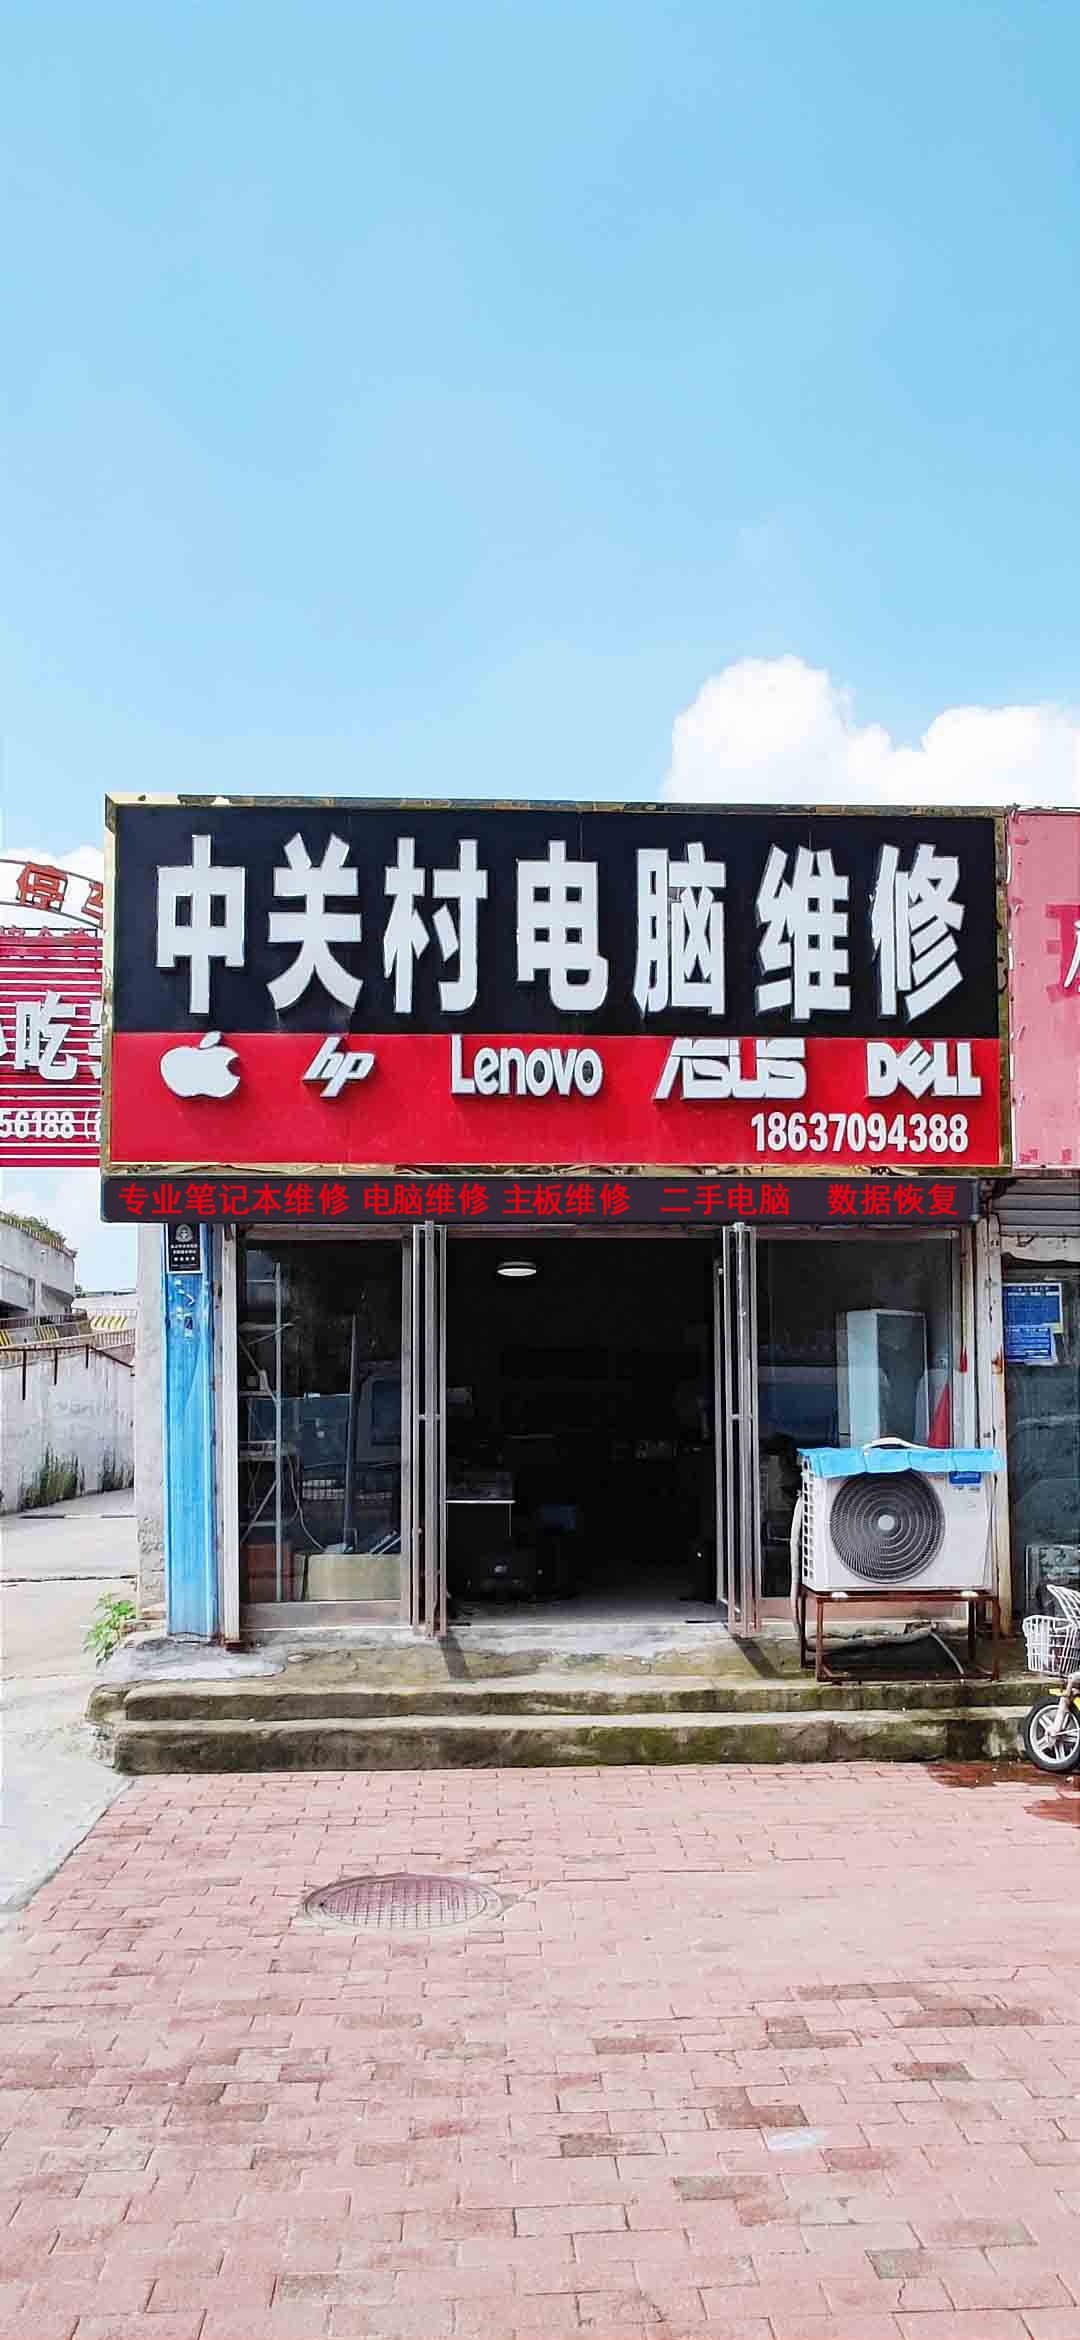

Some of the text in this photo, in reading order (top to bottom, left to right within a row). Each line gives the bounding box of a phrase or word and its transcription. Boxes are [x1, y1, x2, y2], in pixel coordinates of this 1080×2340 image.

[156, 833, 965, 1021] 中关村电脑维修
[303, 1035, 982, 1099] hp Lenovo ASUS DELL
[751, 1111, 969, 1153] 18637094388
[119, 1183, 958, 1215] 专业笔记本维修 电脑维修 主板维修 二手电脑 数据恢复
